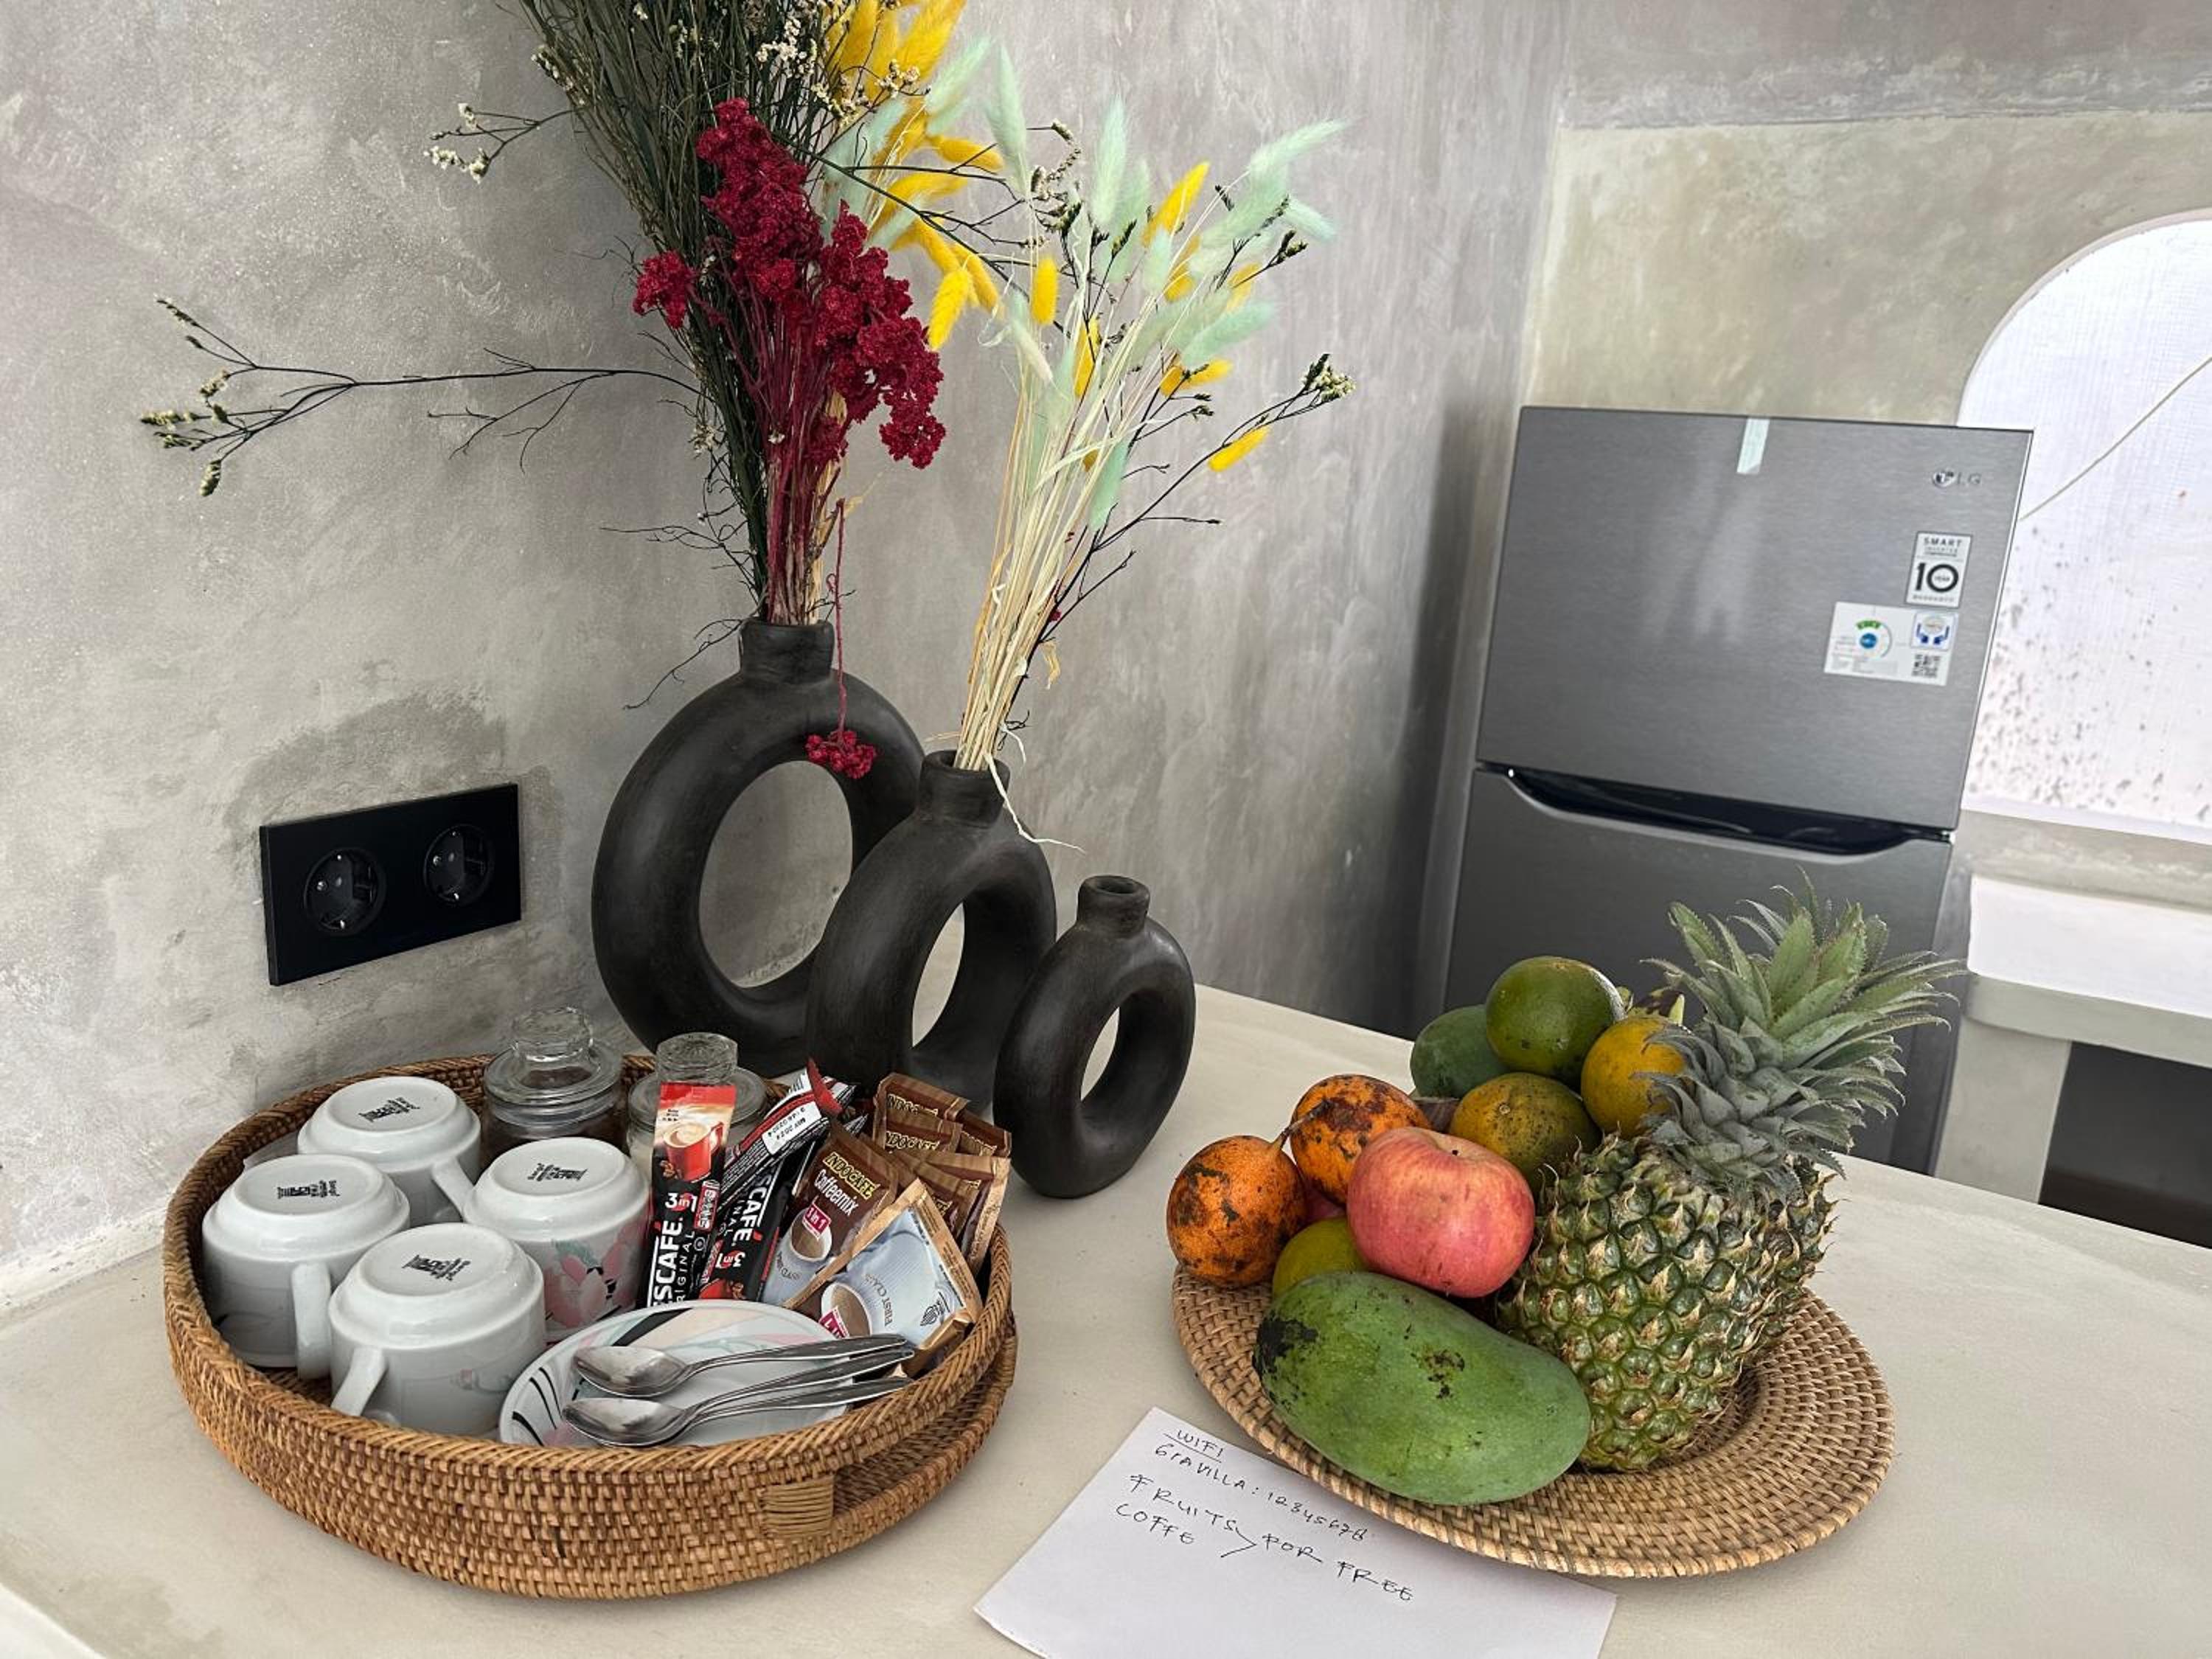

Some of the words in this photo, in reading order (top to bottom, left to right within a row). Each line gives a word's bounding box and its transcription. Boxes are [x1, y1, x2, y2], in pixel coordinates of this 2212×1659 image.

[1924, 537, 1962, 546] SMART
[1915, 563, 1959, 593] 10
[814, 1169, 858, 1217] Coffeemix
[676, 1231, 695, 1303] RIGINAL
[1178, 1430, 1224, 1458] WIFI
[1116, 1503, 1195, 1545] COFFE
[1130, 1474, 1237, 1532] FRUITS
[1267, 1492, 1368, 1541] 12345678
[1337, 1560, 1413, 1601] FREE
